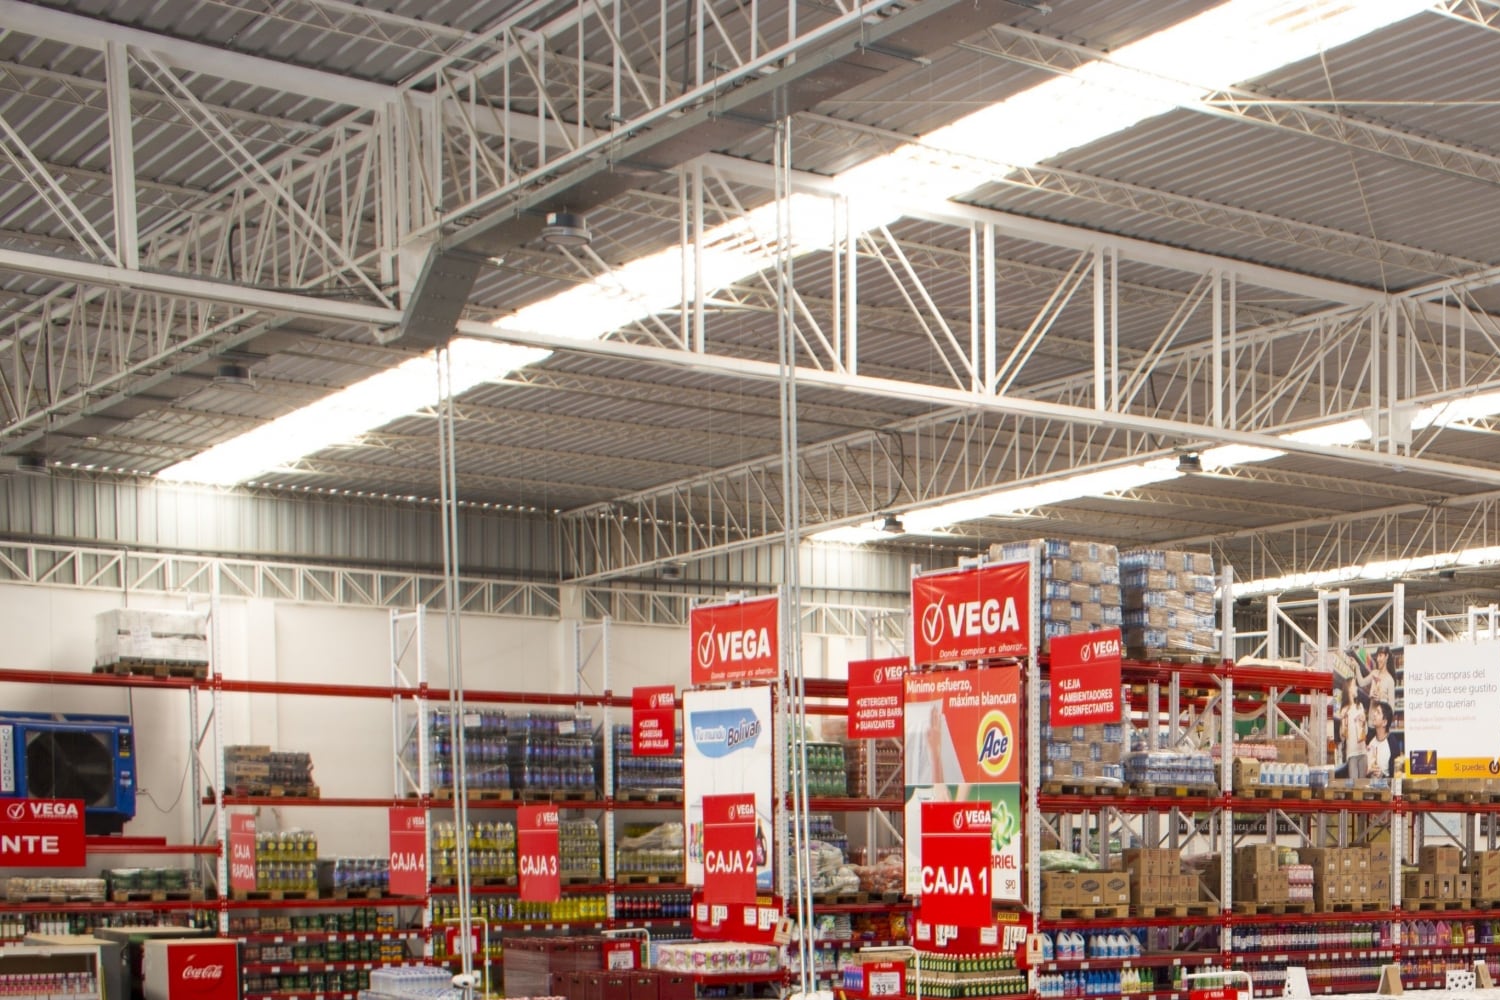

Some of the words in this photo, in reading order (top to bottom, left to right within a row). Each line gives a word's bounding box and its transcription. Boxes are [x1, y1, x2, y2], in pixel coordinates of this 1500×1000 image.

[948, 597, 1020, 638] VEGA
[717, 627, 771, 662] VEGA
[940, 648, 958, 658] Donde
[961, 646, 986, 657] comprar
[989, 645, 996, 653] es
[1093, 640, 1120, 654] VEGA
[1408, 672, 1421, 681] Haz
[1424, 671, 1435, 680] las
[1436, 670, 1471, 681] compras
[1473, 669, 1486, 679] del
[907, 679, 935, 694] Mínimo
[937, 677, 972, 692] esfuerzo,
[1064, 679, 1080, 690] LEJIA
[1431, 685, 1452, 694] dales
[1453, 686, 1467, 694] ese
[1469, 683, 1498, 696] gustito
[658, 694, 674, 706] VEGA
[861, 696, 898, 706] DETERGENTES
[949, 693, 979, 707] máxima
[981, 692, 1017, 706] blancura
[1064, 689, 1113, 703] AMBIENTADORES
[1064, 702, 1114, 716] DESINFECTANTES
[1408, 702, 1422, 711] que
[1424, 700, 1445, 709] tanto
[978, 730, 1008, 762] Ace
[30, 803, 78, 816] VEGA
[736, 804, 754, 815] VEGA
[966, 810, 991, 823] VEGA
[543, 812, 559, 823] VEGA
[234, 844, 250, 858] CAJA
[391, 852, 417, 871] CAJA
[418, 853, 425, 870] 4
[520, 854, 548, 876] CAJA
[550, 856, 557, 875] 3
[706, 850, 743, 873] CAJA
[745, 850, 754, 873] 2
[232, 863, 255, 880] RAPIDA
[921, 865, 974, 895] CAJA
[978, 866, 988, 895] 1
[182, 964, 223, 979] Coca-Cola
